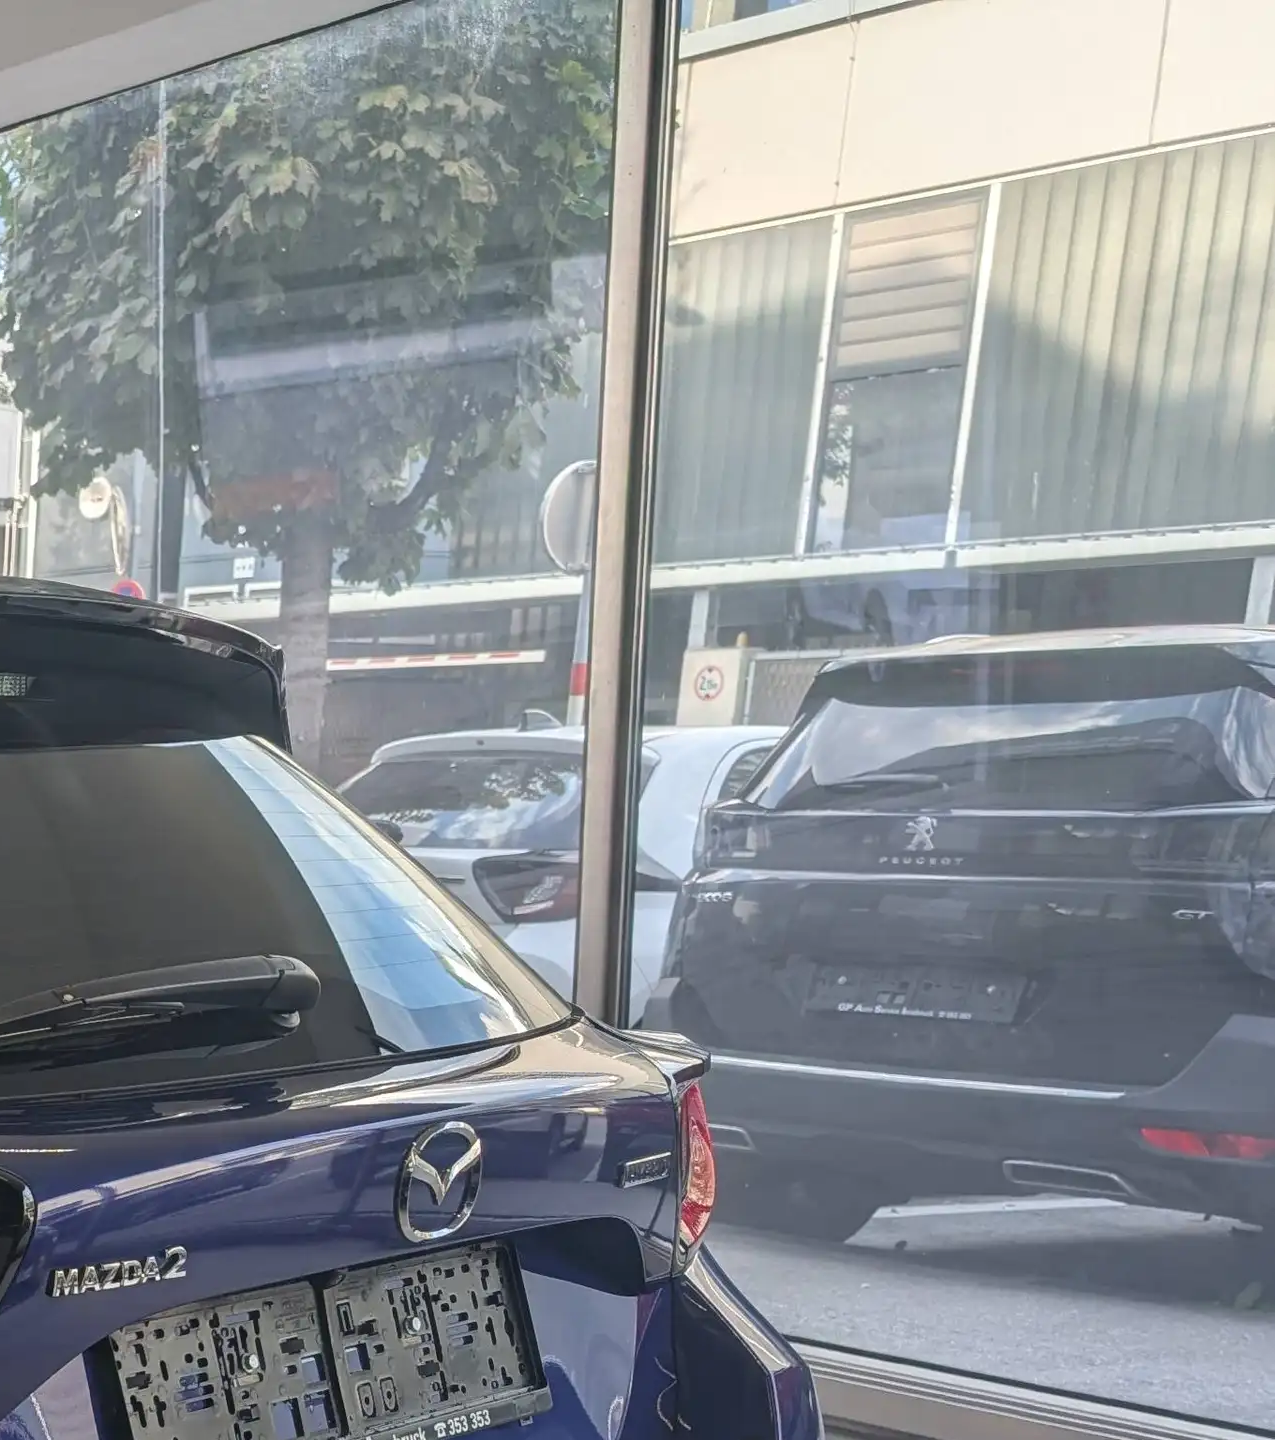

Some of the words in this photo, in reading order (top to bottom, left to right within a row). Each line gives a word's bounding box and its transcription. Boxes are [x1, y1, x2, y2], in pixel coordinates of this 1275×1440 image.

[878, 855, 965, 867] PEUGEOT
[1171, 908, 1215, 920] GT
[448, 1416, 468, 1436] 353
[469, 1409, 491, 1429] 353
